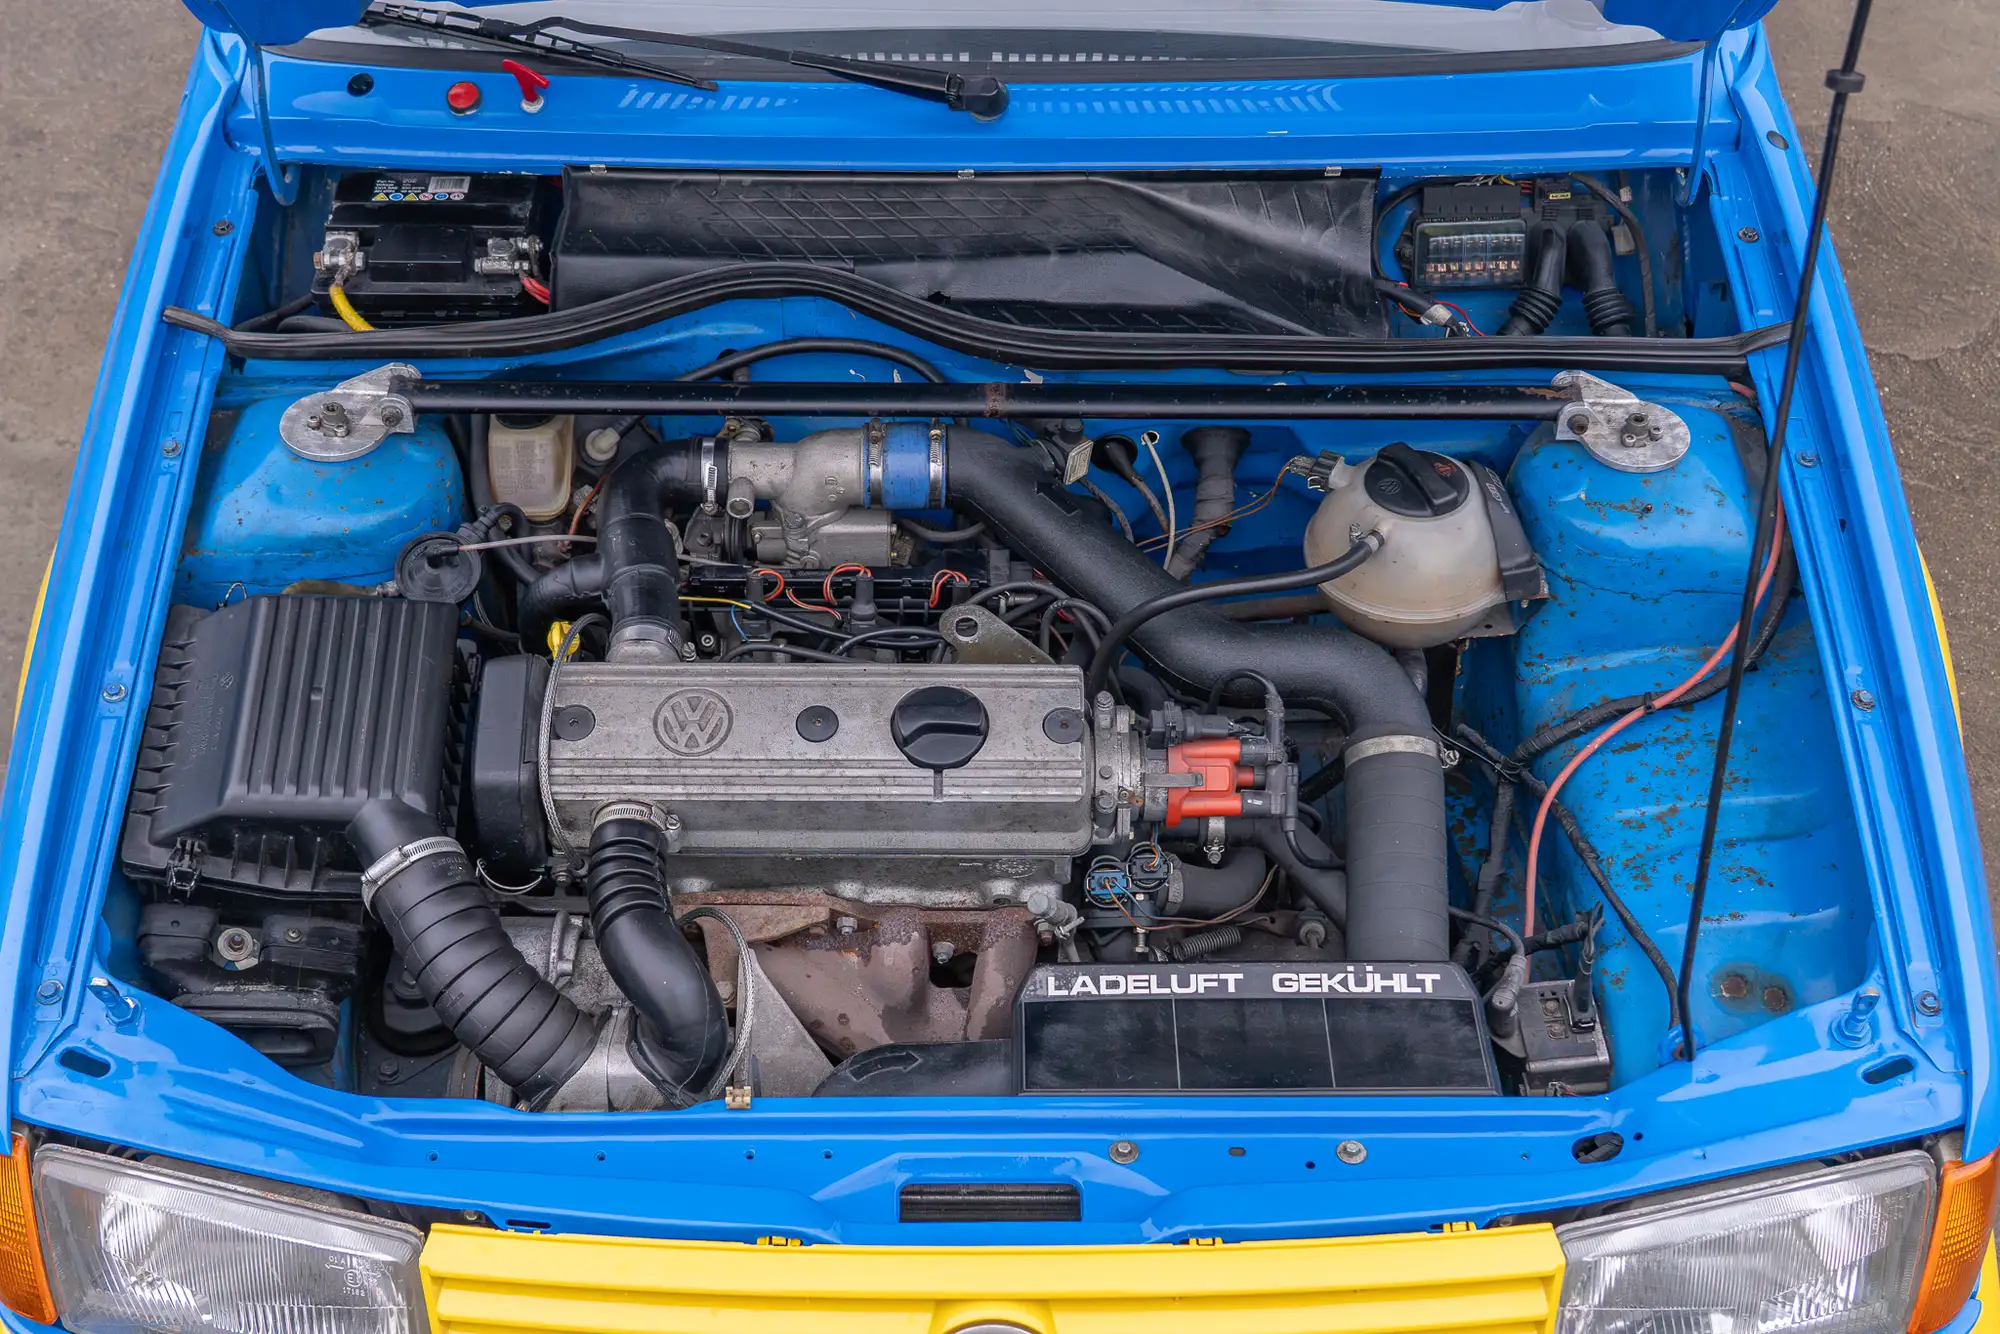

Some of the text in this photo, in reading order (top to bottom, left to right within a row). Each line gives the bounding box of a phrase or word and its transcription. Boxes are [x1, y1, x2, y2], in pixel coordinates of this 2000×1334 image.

[655, 689, 732, 755] VW
[1046, 965, 1441, 996] LADELUFT GEKÜHLT
